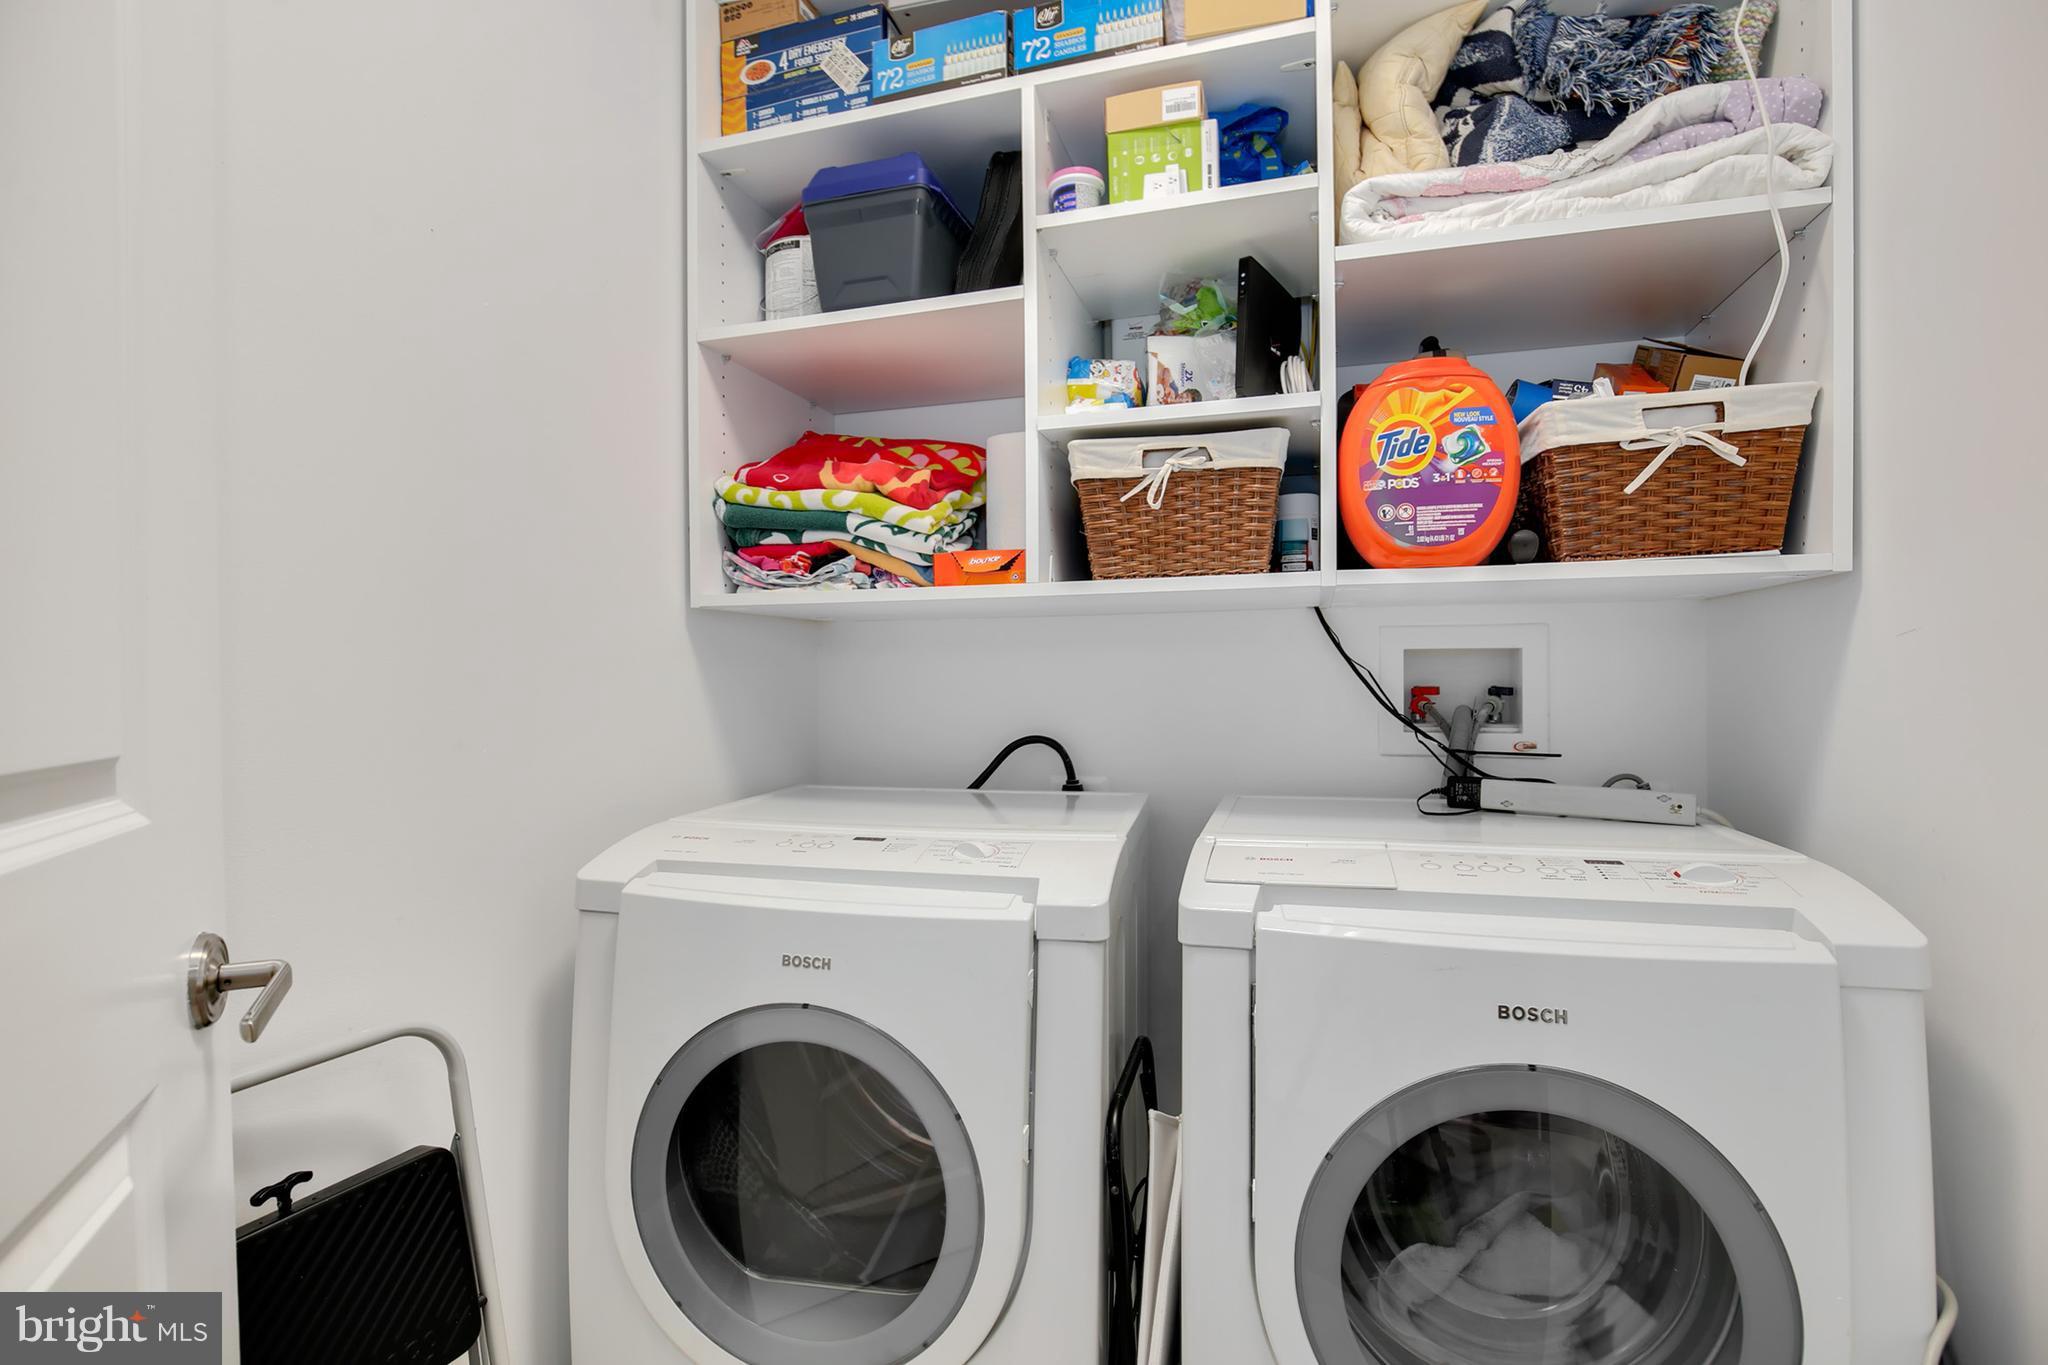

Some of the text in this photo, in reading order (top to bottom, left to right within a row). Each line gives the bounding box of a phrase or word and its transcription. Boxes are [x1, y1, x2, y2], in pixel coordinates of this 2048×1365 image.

[779, 50, 788, 70] 4
[1022, 36, 1050, 63] 72
[877, 67, 904, 92] 72
[1376, 427, 1432, 469] Tide
[1387, 477, 1420, 490] PODS
[782, 954, 832, 971] BOSCH
[1497, 1004, 1568, 1025] BOSCH
